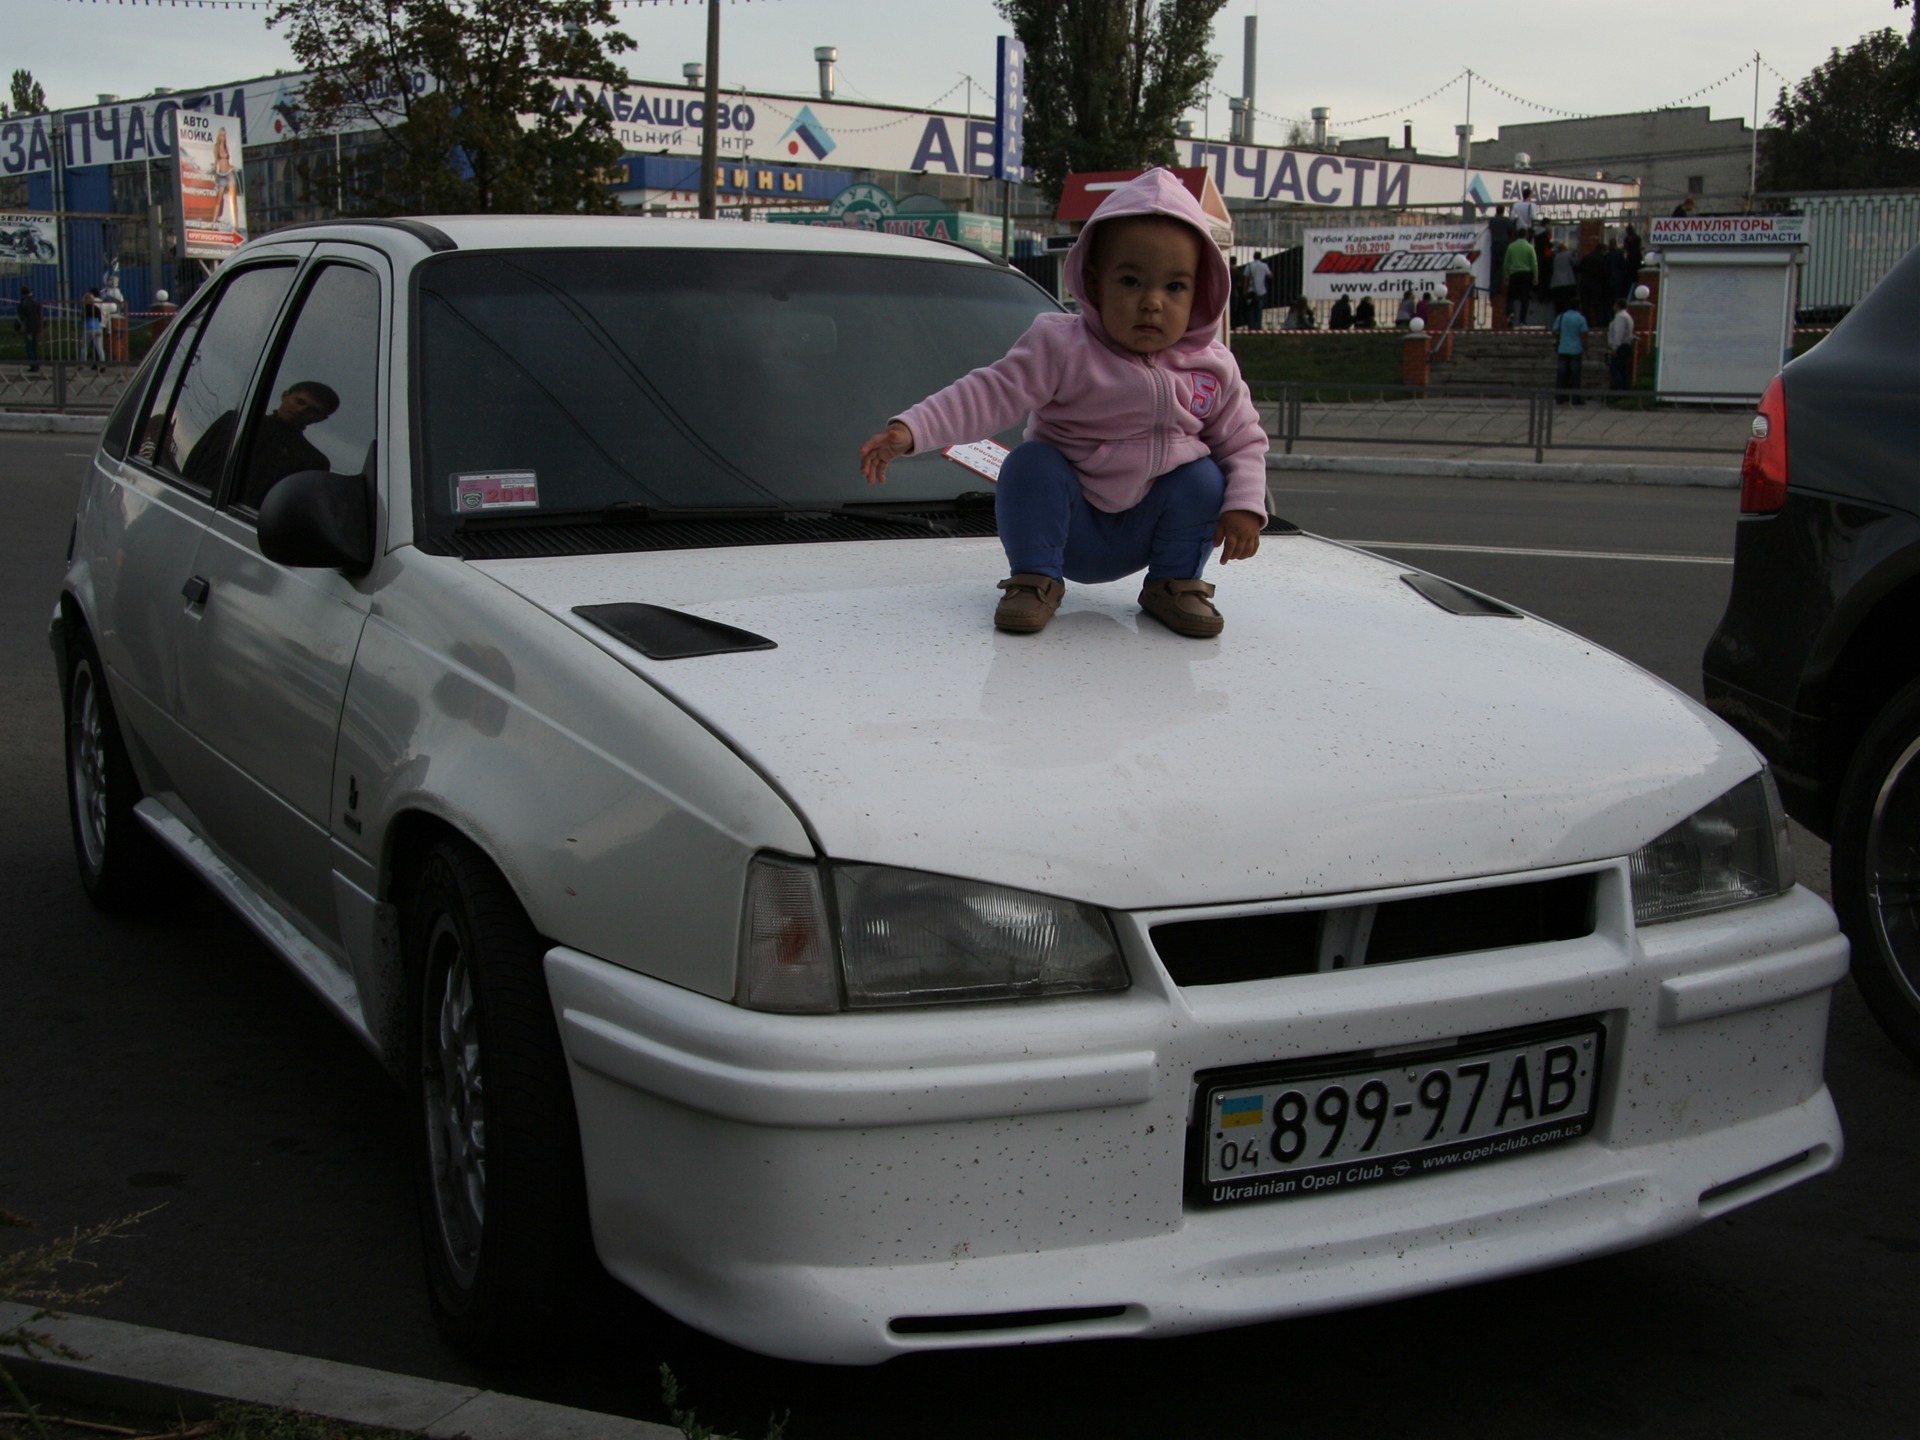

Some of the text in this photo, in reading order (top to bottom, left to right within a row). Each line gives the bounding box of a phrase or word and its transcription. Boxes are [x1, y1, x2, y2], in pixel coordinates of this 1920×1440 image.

[549, 85, 755, 132] АРАБАШОВО
[1008, 49, 1019, 154] МОЙКА
[183, 115, 209, 129] АВТО
[2, 88, 248, 174] ЗАПЧАСИ
[180, 129, 214, 143] МОЙКА
[0, 215, 53, 223] SERVICE
[1654, 219, 1773, 232] АККУМУЛЯТОРЫ
[1313, 235, 1343, 244] Кубок
[1346, 234, 1395, 243] Харькова
[1414, 232, 1478, 241] ДРИФТИНГУ
[1652, 233, 1801, 242] МАСЛА ТОСОЛ ЗАПЧАСТИ
[1345, 242, 1390, 253] 19.09.2010
[1330, 279, 1446, 293] www.drift.in
[1191, 372, 1217, 418] 5
[485, 488, 535, 503] 2011
[1220, 1137, 1259, 1171] 04
[1212, 1124, 1582, 1201] Ukrainian Opel Club www.opel-club.com.ua
